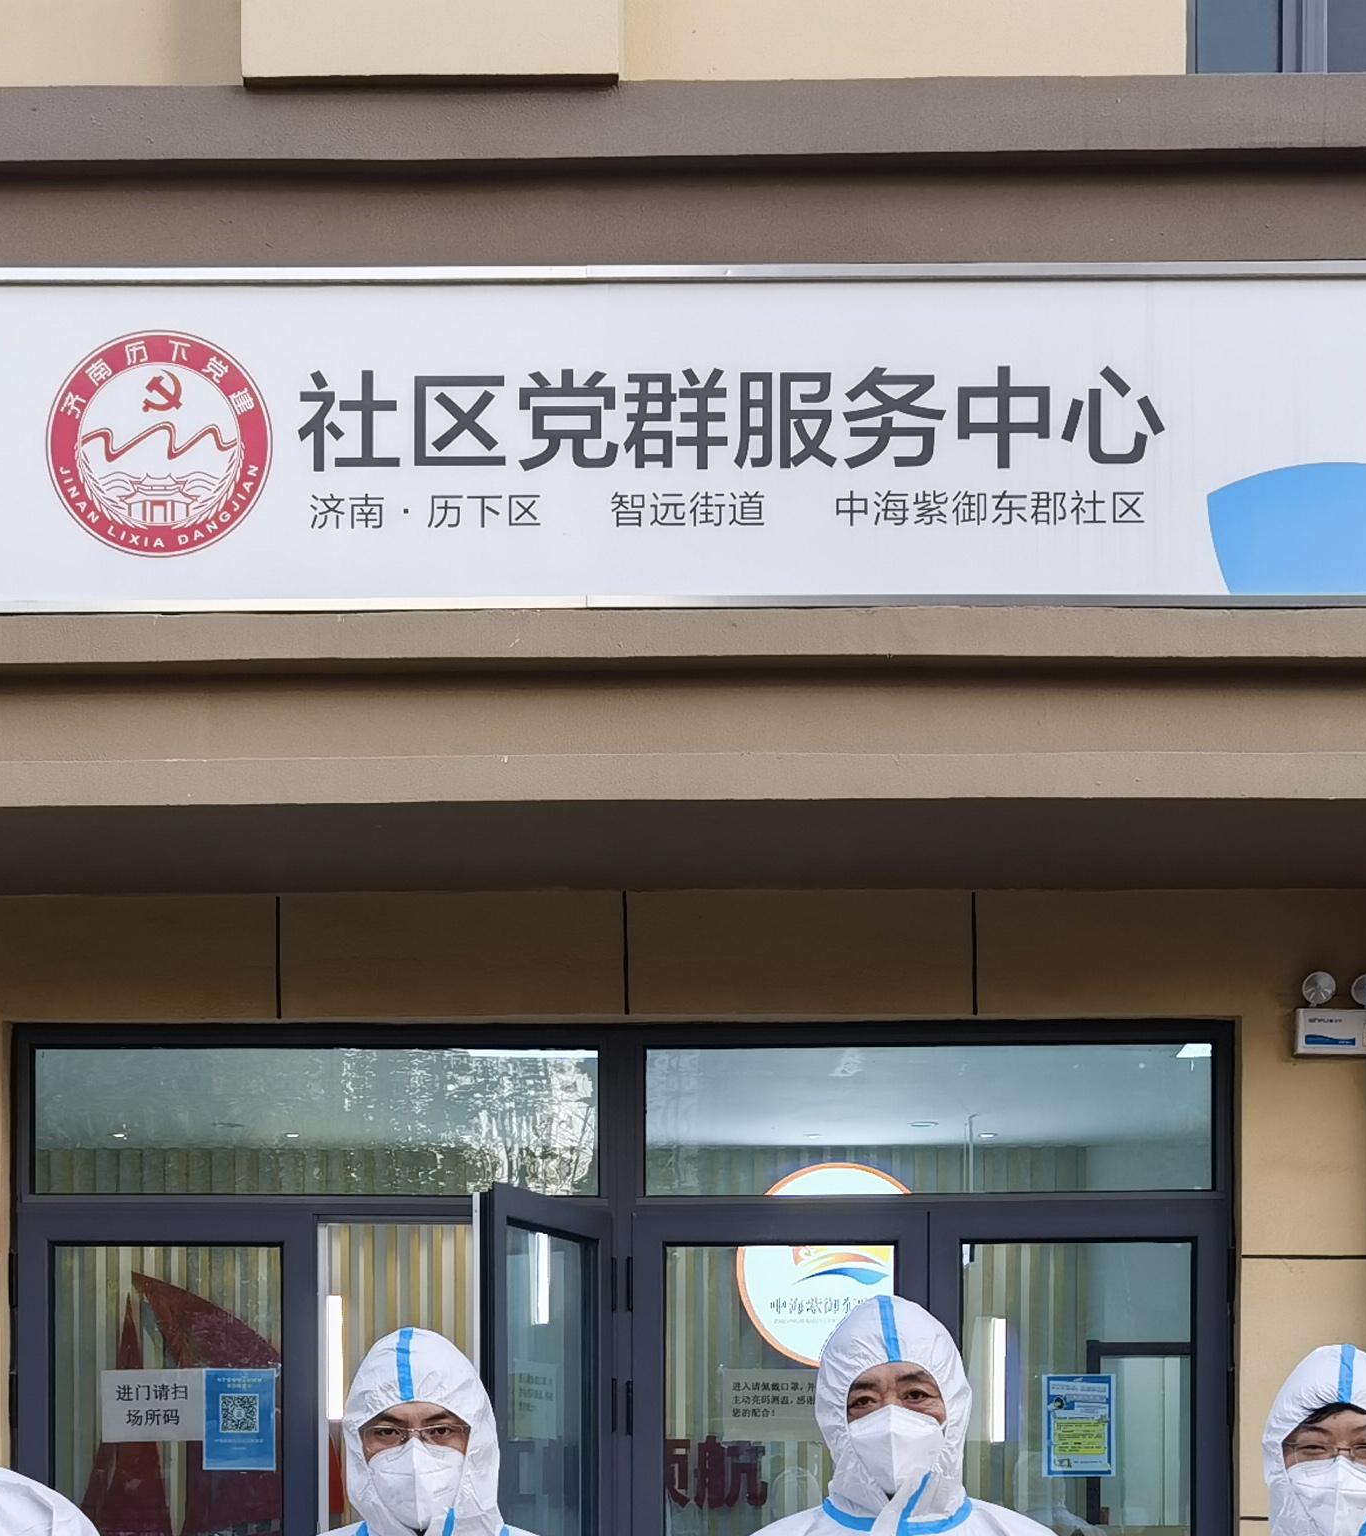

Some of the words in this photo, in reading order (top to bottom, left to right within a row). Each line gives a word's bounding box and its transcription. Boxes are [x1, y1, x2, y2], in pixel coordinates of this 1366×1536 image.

[59, 339, 255, 419] 济南历下党建
[297, 366, 1166, 472] 社区党群服务中心
[59, 465, 101, 524] JINAN
[106, 524, 166, 549] LIXIA
[177, 464, 260, 546] DANGJIAN
[610, 490, 766, 529] 智远街道
[834, 489, 1146, 527] 中海紫御东郡社区
[115, 1382, 189, 1402] 进门请扫
[125, 1408, 180, 1427] 场所码
